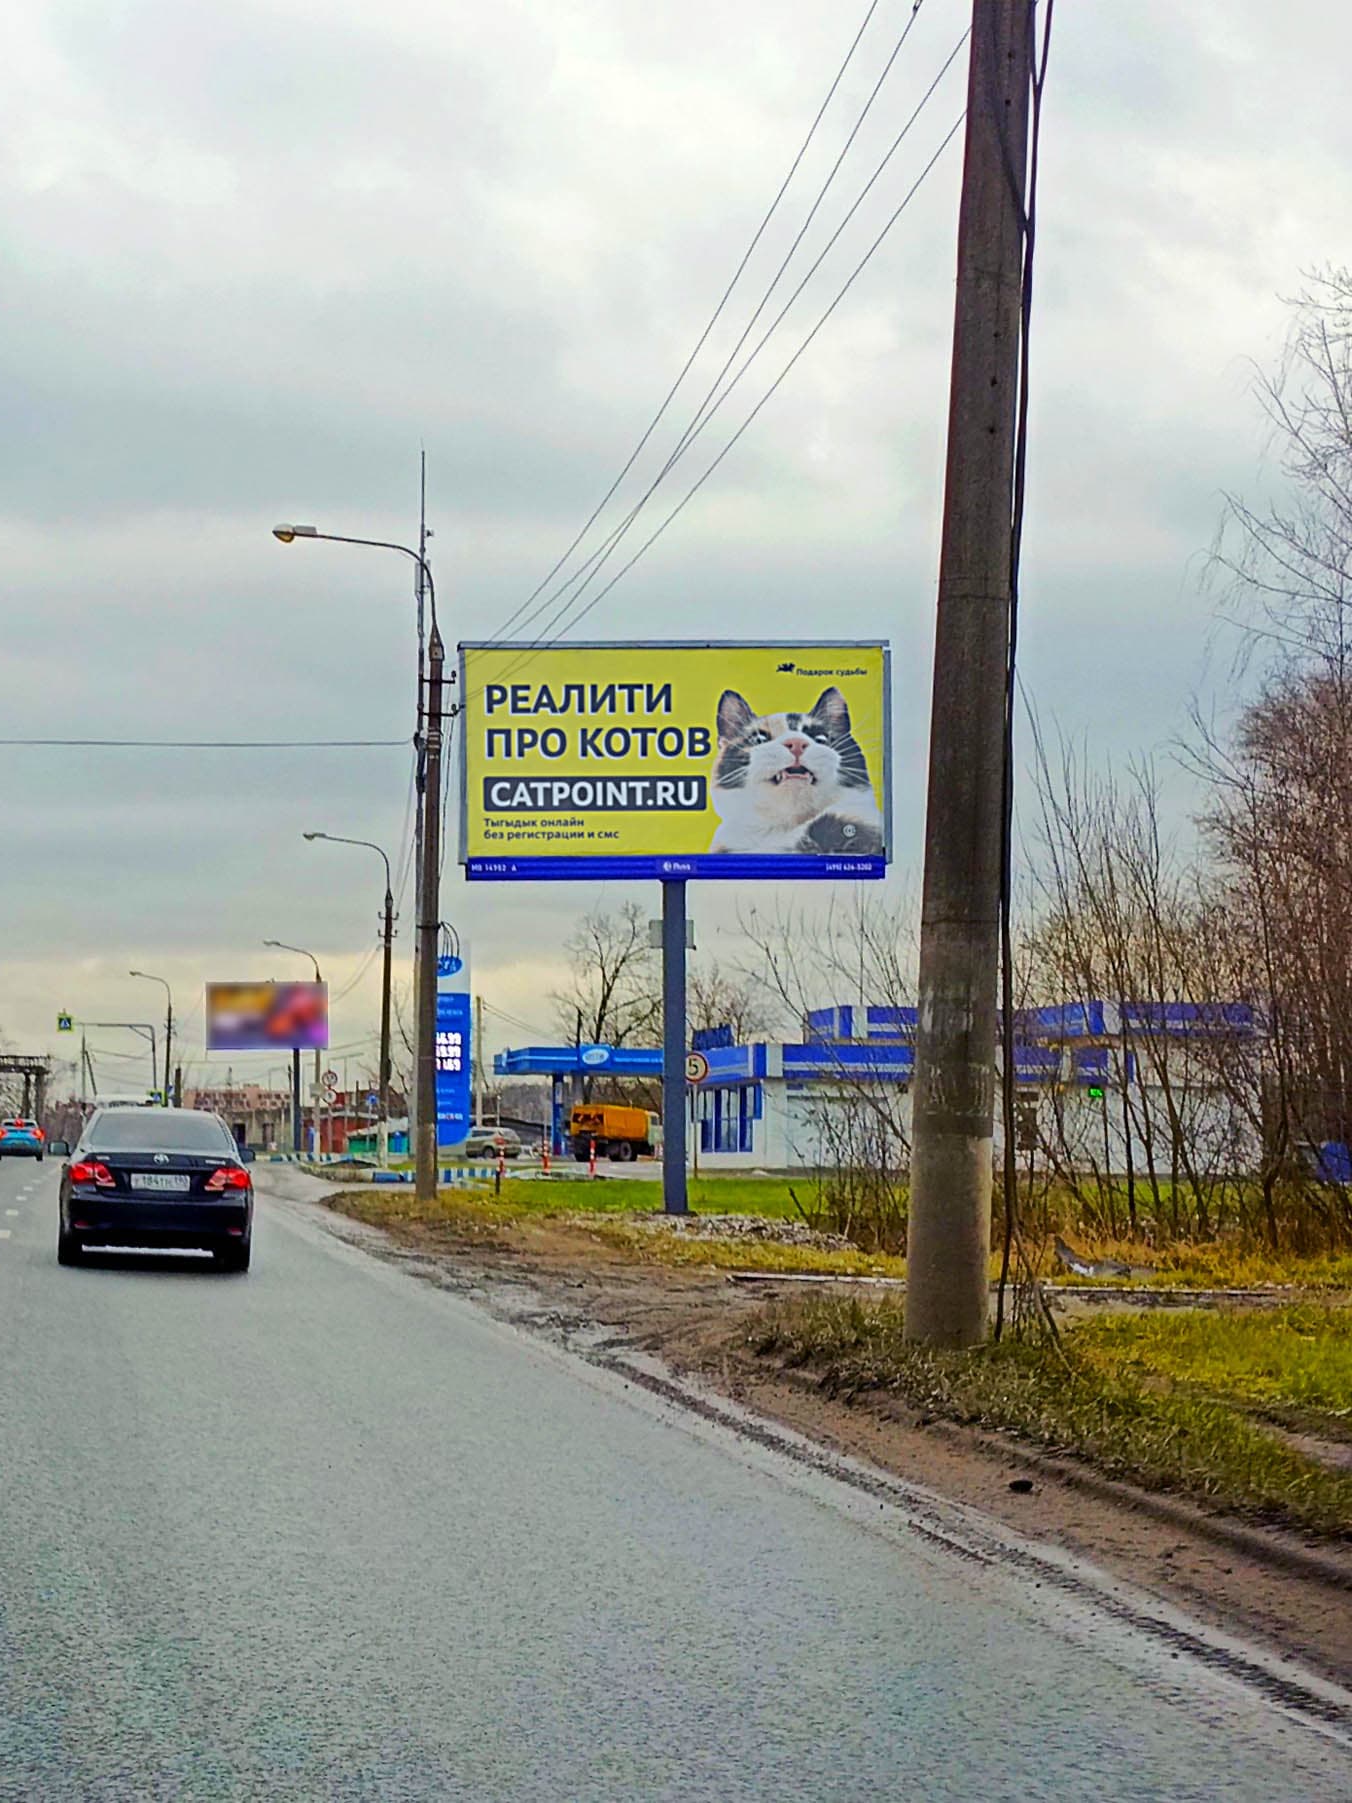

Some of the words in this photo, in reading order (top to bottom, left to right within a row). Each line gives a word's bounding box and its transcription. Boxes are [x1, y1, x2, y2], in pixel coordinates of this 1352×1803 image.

[485, 684, 672, 714] РЕАЛИТИ
[486, 728, 567, 758] ПРО
[580, 727, 711, 758] КОТОВ
[490, 781, 698, 807] CATPOINT.RU
[484, 818, 537, 828] Тыгыдык
[540, 816, 584, 827] онлайн
[484, 829, 504, 839] без
[507, 831, 584, 841] регистрации
[587, 831, 595, 839] и
[598, 830, 619, 839] смс
[689, 1058, 699, 1076] 5
